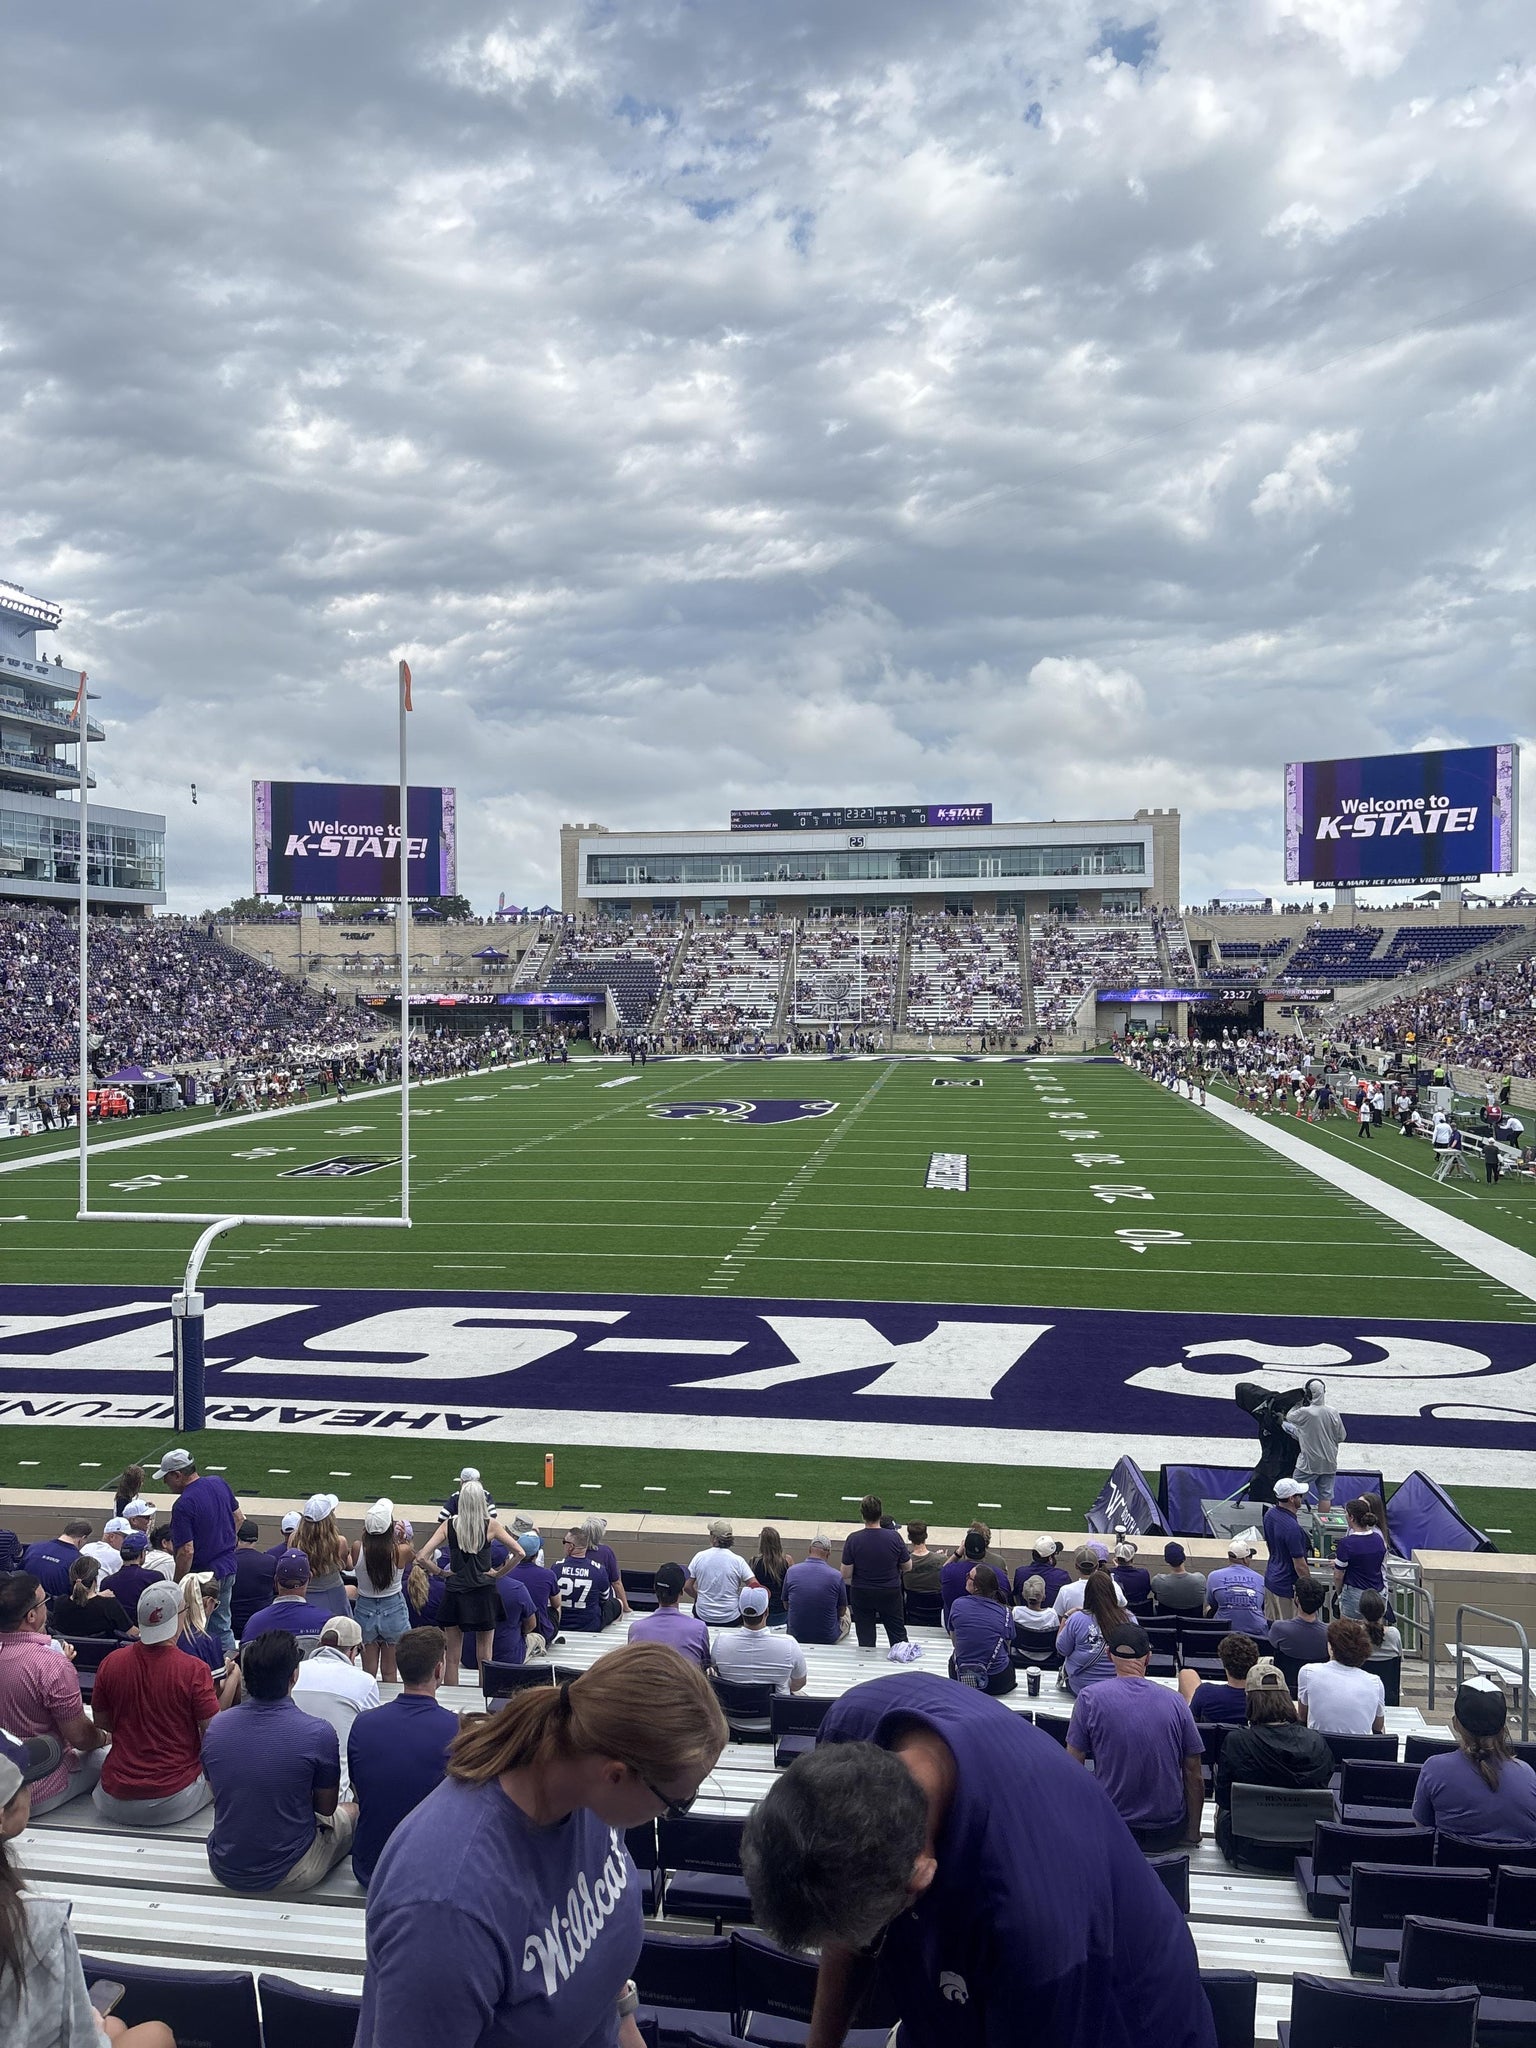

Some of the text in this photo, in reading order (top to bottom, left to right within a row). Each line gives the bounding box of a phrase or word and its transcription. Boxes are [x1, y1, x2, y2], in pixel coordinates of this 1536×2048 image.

[1342, 794, 1449, 815] Welcome to
[937, 807, 985, 818] K-STATE
[800, 817, 806, 827] 0
[920, 814, 926, 824] 0
[1315, 806, 1478, 840] K-STATE!
[308, 820, 383, 836] Welcome
[850, 837, 865, 847] 25
[1316, 875, 1478, 888] CARL & MARY ICE FAMILY VIDEO BOARD
[284, 894, 302, 902] CARL
[314, 895, 336, 903] MARY
[338, 895, 350, 903] ICE
[468, 994, 495, 1004] 23:27
[1222, 990, 1252, 1000] 23:27
[1072, 1153, 1126, 1165] 30
[108, 1174, 190, 1190] 20
[1088, 1184, 1156, 1200] 20
[1114, 1228, 1192, 1247] 10
[561, 1566, 590, 1578] NELSON
[556, 1577, 593, 1609] 27
